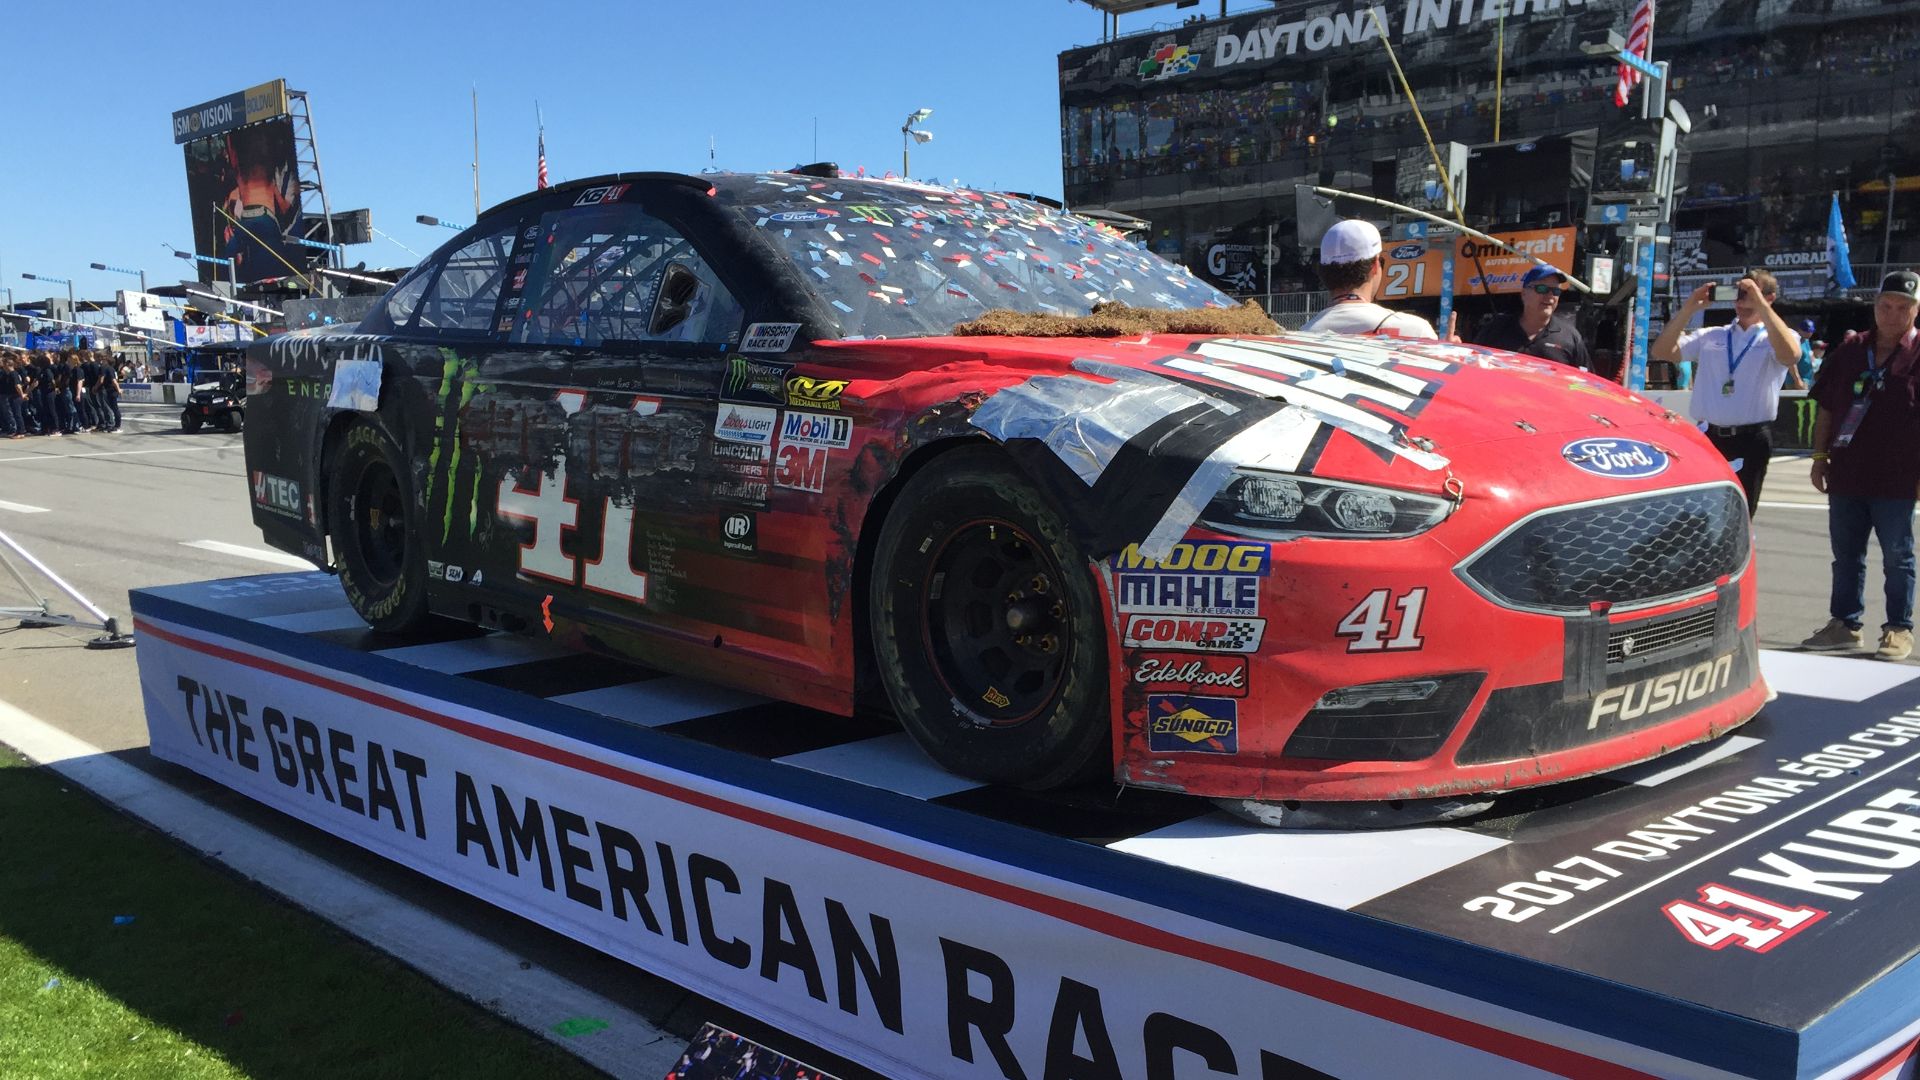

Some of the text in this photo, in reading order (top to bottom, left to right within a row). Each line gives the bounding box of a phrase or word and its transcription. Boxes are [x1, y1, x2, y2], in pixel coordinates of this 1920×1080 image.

[1214, 6, 1390, 67] DAYTONA
[174, 116, 190, 137] ISM
[199, 102, 233, 129] VISION
[1393, 245, 1421, 259] Ford
[1461, 234, 1566, 258] Omnicraft
[1485, 257, 1508, 266] AUTO
[1764, 251, 1828, 266] GATORAD
[1385, 262, 1426, 296] 21
[1485, 272, 1519, 285] Quick
[747, 338, 785, 348] RACE CAR
[757, 325, 791, 337] NASCAR
[286, 379, 332, 400] ENER
[822, 399, 841, 411] WEAR
[748, 419, 771, 431] LIGHT
[784, 413, 830, 440] Mobil
[714, 442, 761, 461] LINCOLN
[776, 444, 827, 491] 3M
[496, 388, 655, 604] 41
[728, 517, 745, 536] IR
[1117, 542, 1266, 573] MOOG
[1120, 574, 1257, 609] MAHLE
[1186, 607, 1255, 616] ENGINE BEARINGS
[1334, 586, 1427, 654] 41
[1131, 618, 1228, 643] COMP
[1195, 639, 1244, 650] CAMS
[1134, 659, 1244, 688] Edelbrock
[1586, 653, 1733, 731] FUSION
[1154, 716, 1231, 735] SUNOCO
[1462, 854, 1624, 923] 2017
[1592, 776, 1820, 863] DAYTONA
[1779, 742, 1886, 782] 500
[177, 675, 260, 773] THE
[262, 706, 428, 841] GREAT
[455, 771, 904, 1036] AMERICAN
[1660, 882, 1831, 954] 41
